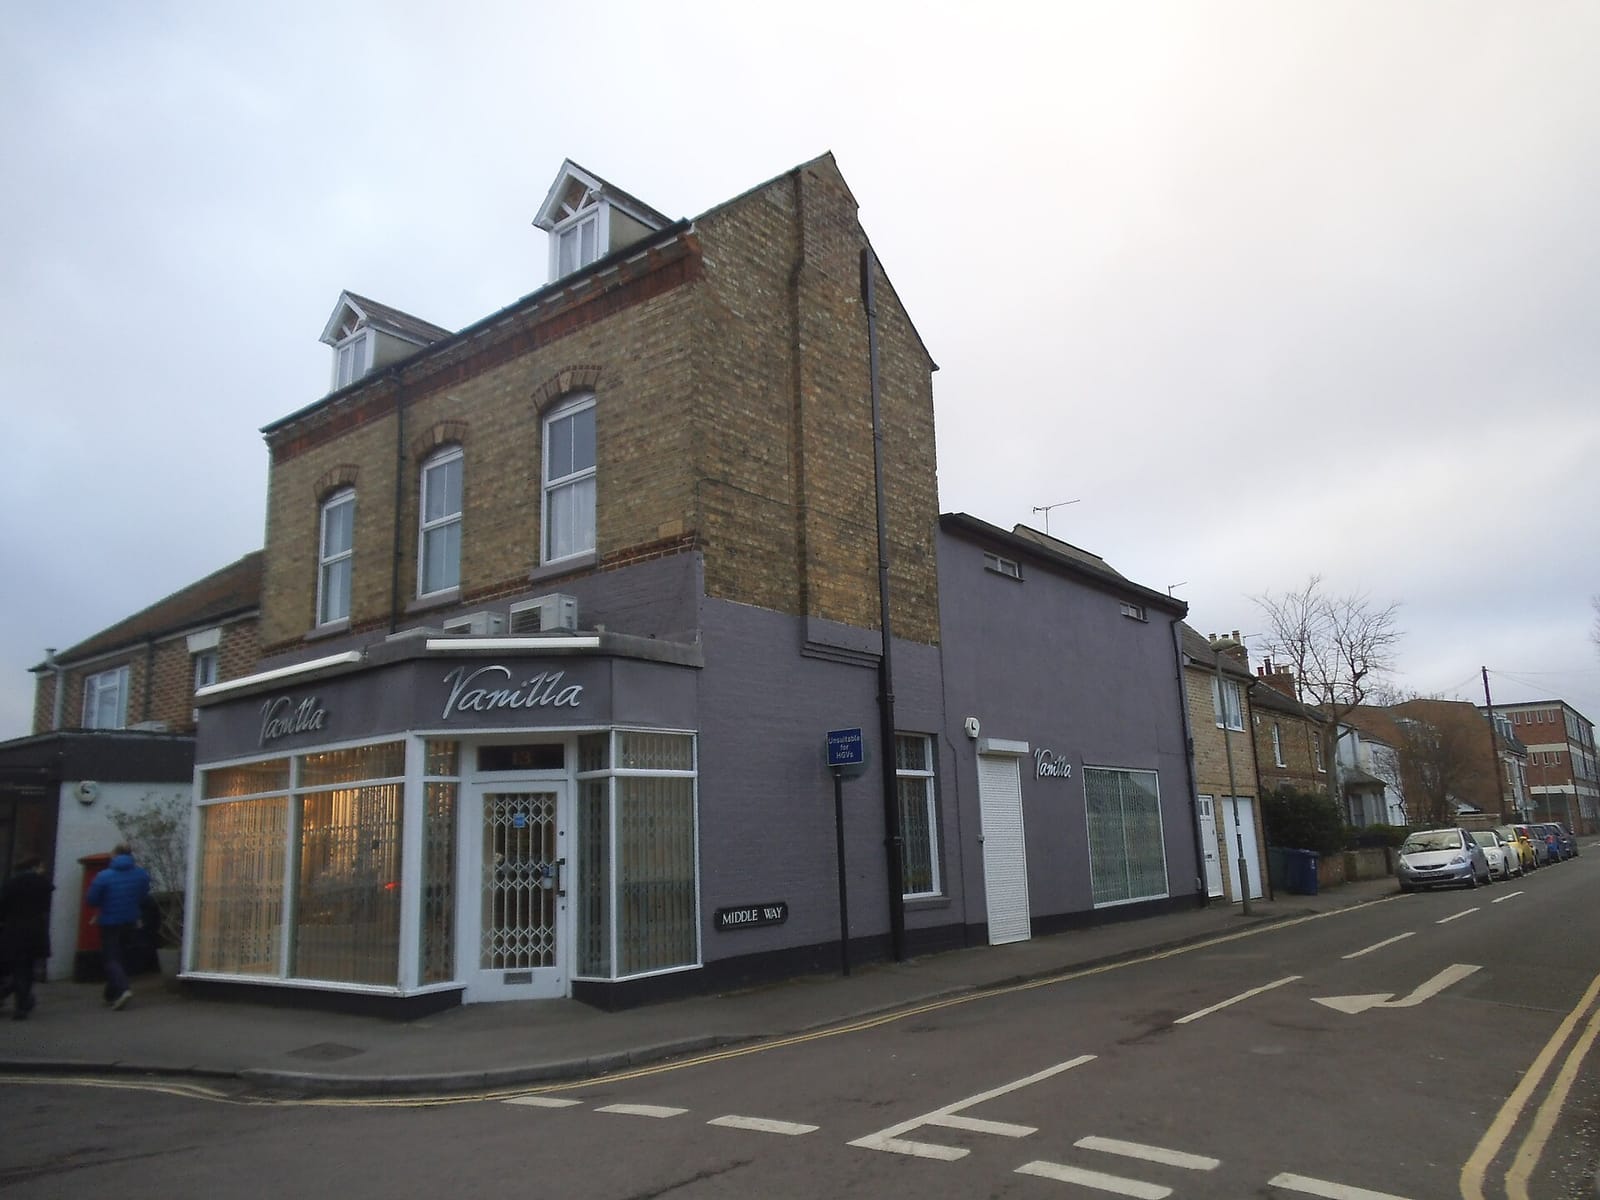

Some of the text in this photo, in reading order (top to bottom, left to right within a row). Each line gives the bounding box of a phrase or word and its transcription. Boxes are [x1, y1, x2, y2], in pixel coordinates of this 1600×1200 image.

[443, 665, 584, 720] Vanilla
[258, 696, 326, 747] Vanilla
[829, 735, 860, 744] Unsuitable
[836, 751, 854, 759] HGVs
[1034, 747, 1072, 781] Vanilla
[722, 906, 783, 925] MIDDLE WAY
